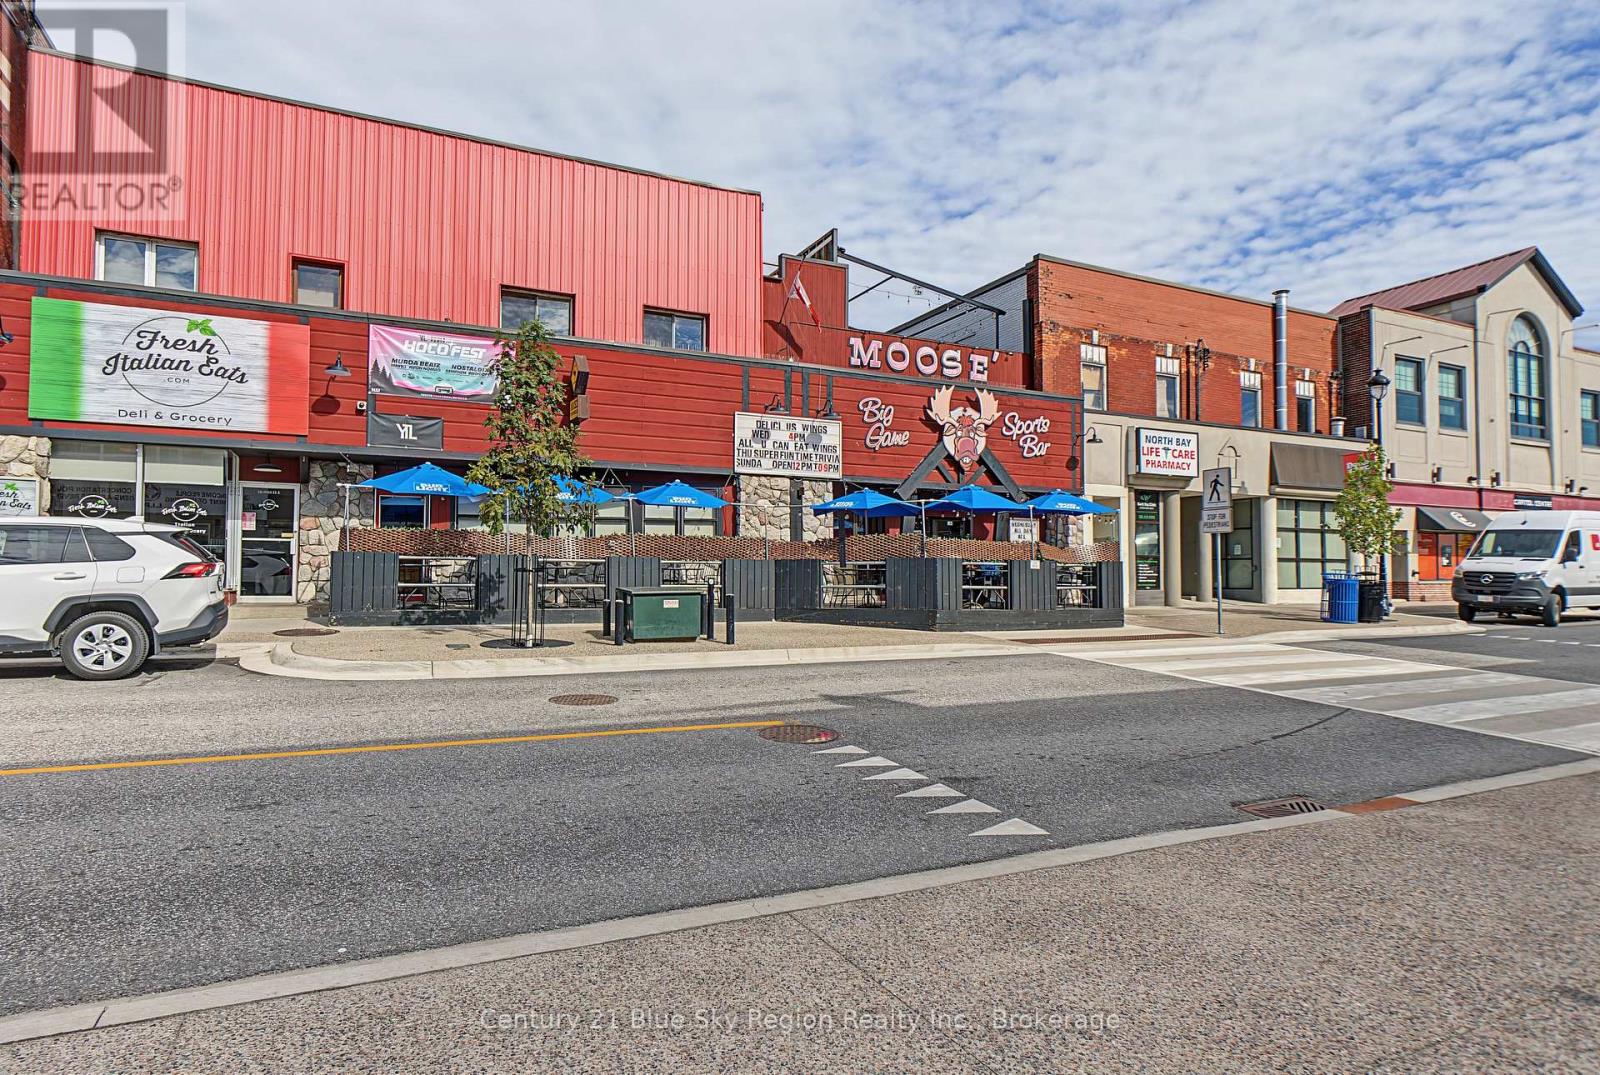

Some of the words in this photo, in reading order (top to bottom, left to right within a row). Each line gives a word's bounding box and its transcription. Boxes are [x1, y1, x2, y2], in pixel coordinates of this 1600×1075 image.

[135, 329, 219, 355] Fresh
[101, 352, 195, 376] Italian
[198, 355, 249, 385] Eats
[117, 409, 149, 420] Deli
[154, 411, 163, 420] &
[170, 412, 233, 426] Grocery
[858, 396, 895, 427] Big
[802, 424, 828, 435] WINGS
[1001, 411, 1051, 440] Sports
[752, 429, 770, 440] WED
[788, 432, 806, 442] 4PM
[864, 422, 911, 451] Game
[1145, 434, 1173, 446] NORTH
[1175, 437, 1192, 447] BAY
[738, 439, 754, 448] ALL
[761, 440, 767, 448] U
[772, 441, 789, 451] CAN
[794, 443, 810, 451] EAT
[812, 444, 838, 454] WINGS
[1019, 434, 1051, 459] Bar
[1141, 446, 1161, 457] LIFE
[1171, 448, 1196, 460] CARE
[1145, 459, 1192, 471] PHARMACY
